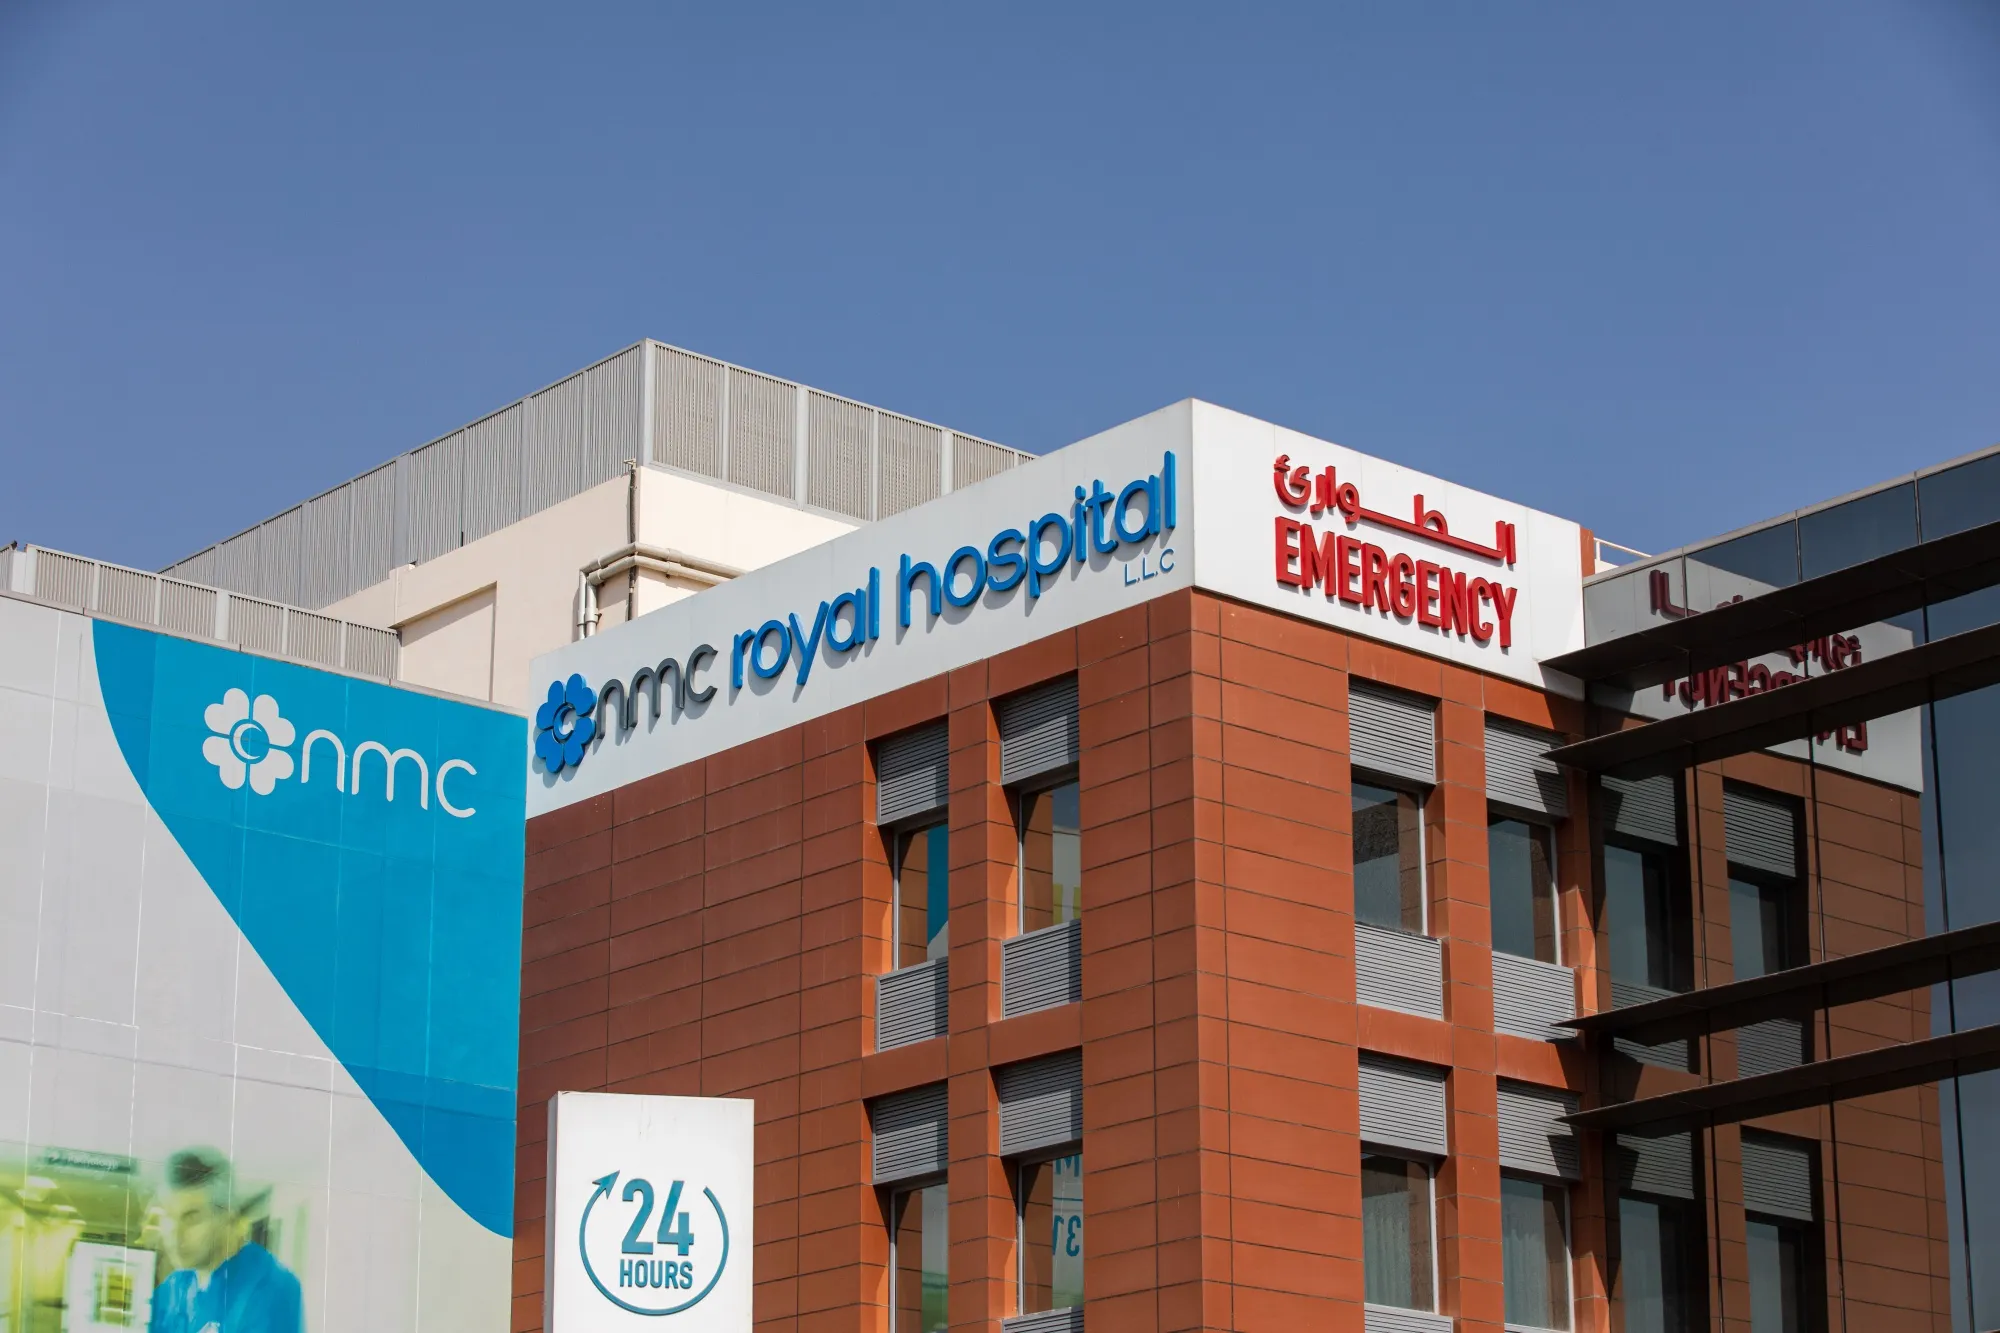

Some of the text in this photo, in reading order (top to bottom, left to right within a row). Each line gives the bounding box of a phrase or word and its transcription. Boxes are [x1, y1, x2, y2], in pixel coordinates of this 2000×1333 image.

[1273, 454, 1517, 565] الطوارئ
[597, 450, 1176, 740] nmc royal hospital
[1275, 516, 1518, 648] EMERGENCY
[301, 728, 477, 819] nmc
[621, 1178, 694, 1256] 24
[619, 1258, 693, 1290] HOURS
